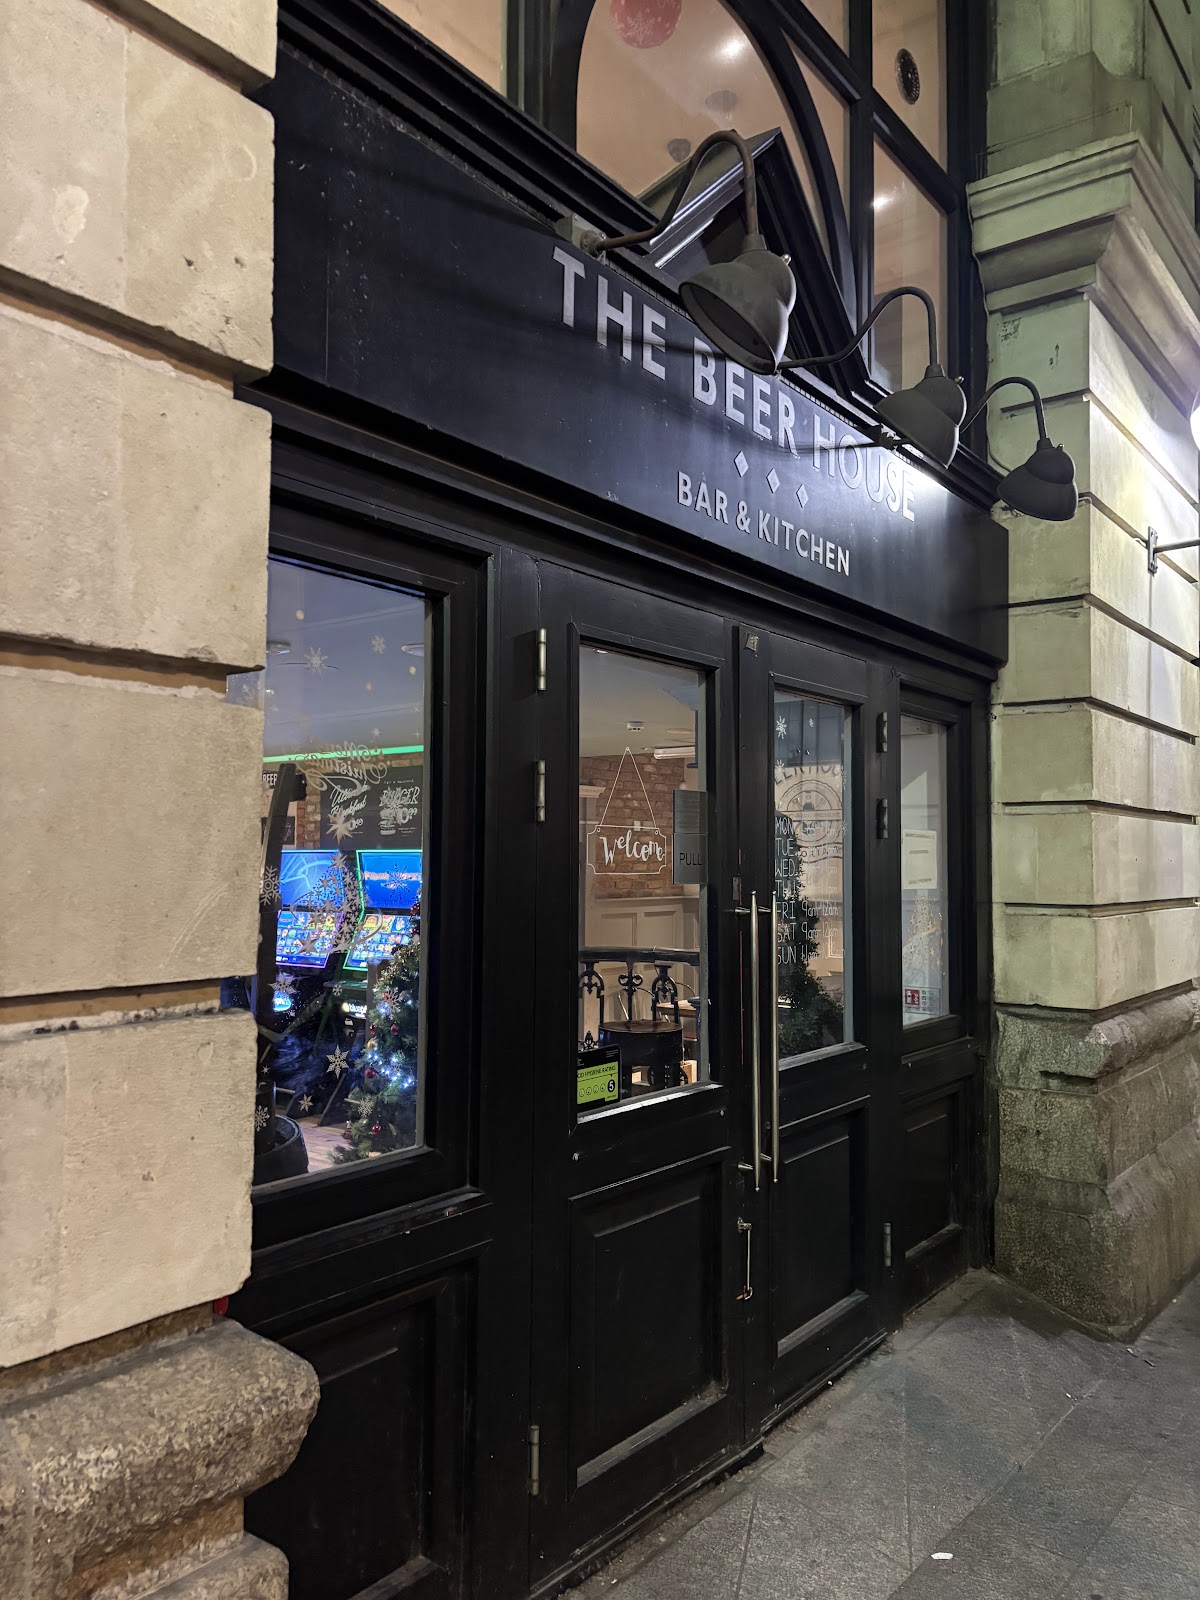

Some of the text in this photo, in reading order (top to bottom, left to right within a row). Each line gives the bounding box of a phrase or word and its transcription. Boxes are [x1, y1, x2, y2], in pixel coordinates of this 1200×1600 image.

[553, 245, 916, 522] THE BEER HOUSE
[677, 470, 851, 577] BAR & KITCHEN
[775, 816, 794, 836] MON
[599, 830, 665, 867] Welcome
[775, 837, 795, 856] TUE
[680, 852, 702, 865] PULL
[774, 858, 795, 877] WED
[775, 901, 796, 919] FRI
[777, 922, 797, 942] SAT
[777, 946, 797, 964] SUN
[608, 1080, 614, 1092] 5
